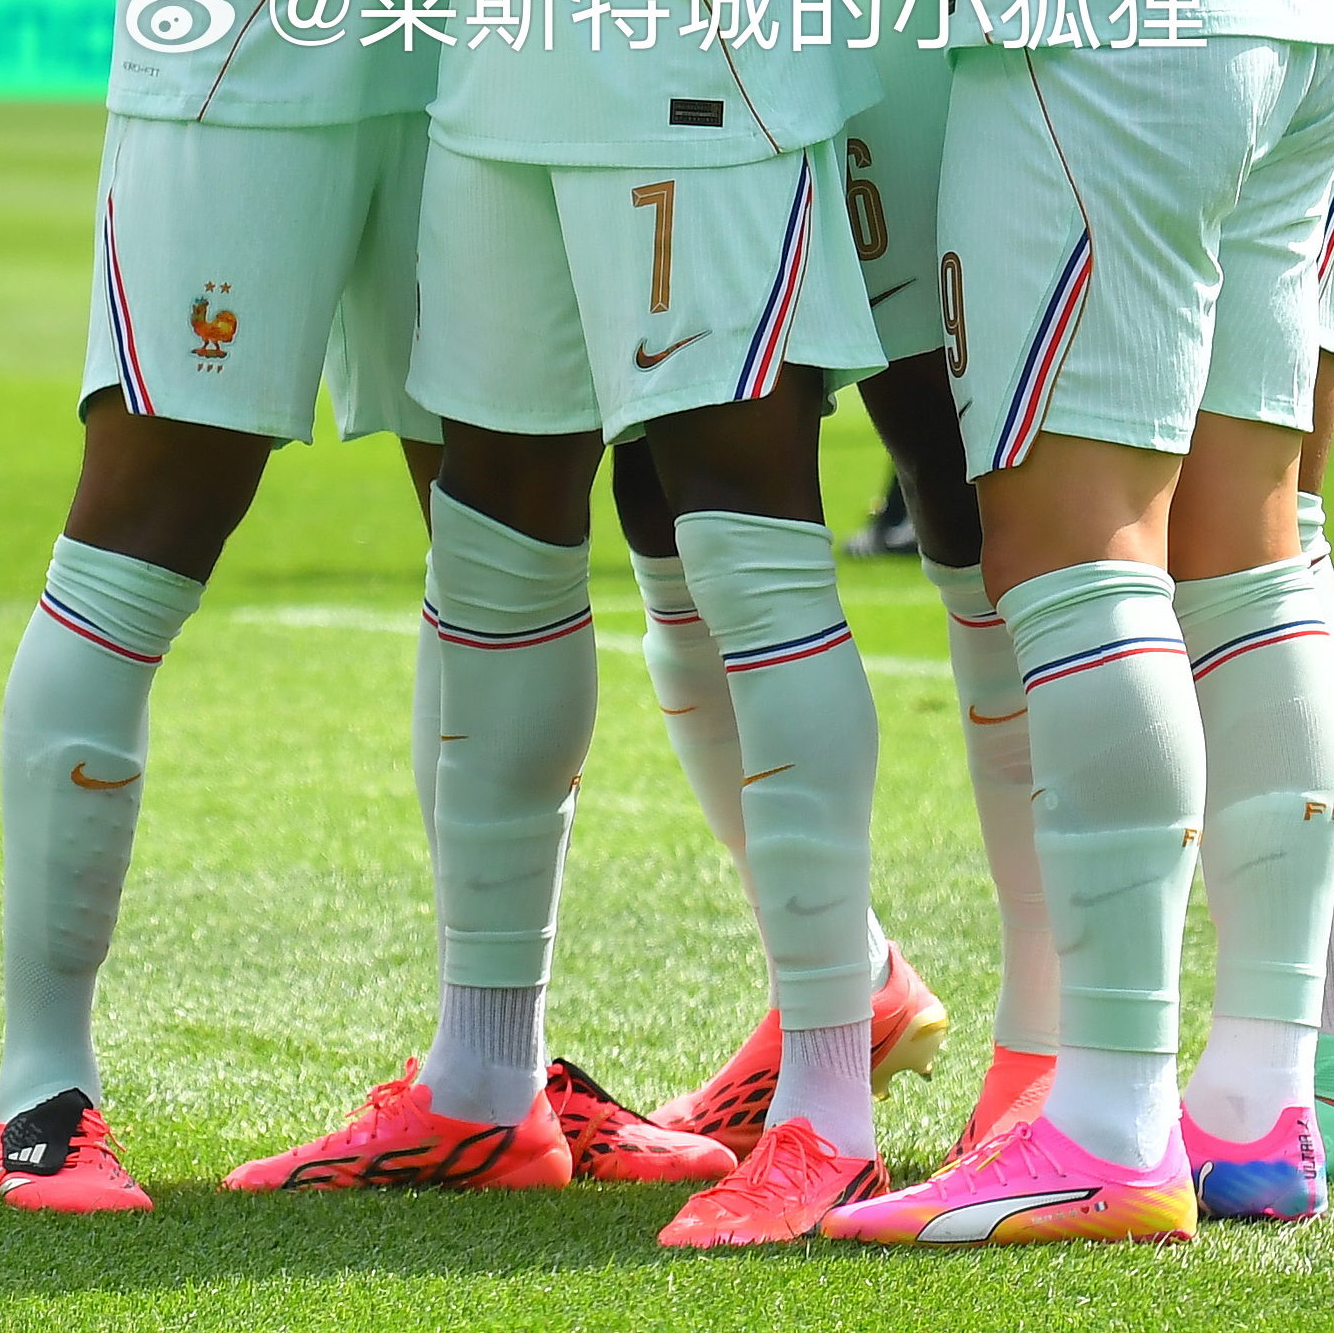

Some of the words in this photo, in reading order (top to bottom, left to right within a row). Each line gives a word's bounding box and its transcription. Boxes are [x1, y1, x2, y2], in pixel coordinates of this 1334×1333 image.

[631, 179, 675, 314] 7
[846, 138, 889, 261] 6
[941, 251, 968, 379] 9
[1298, 1134, 1317, 1180] ULTRA
